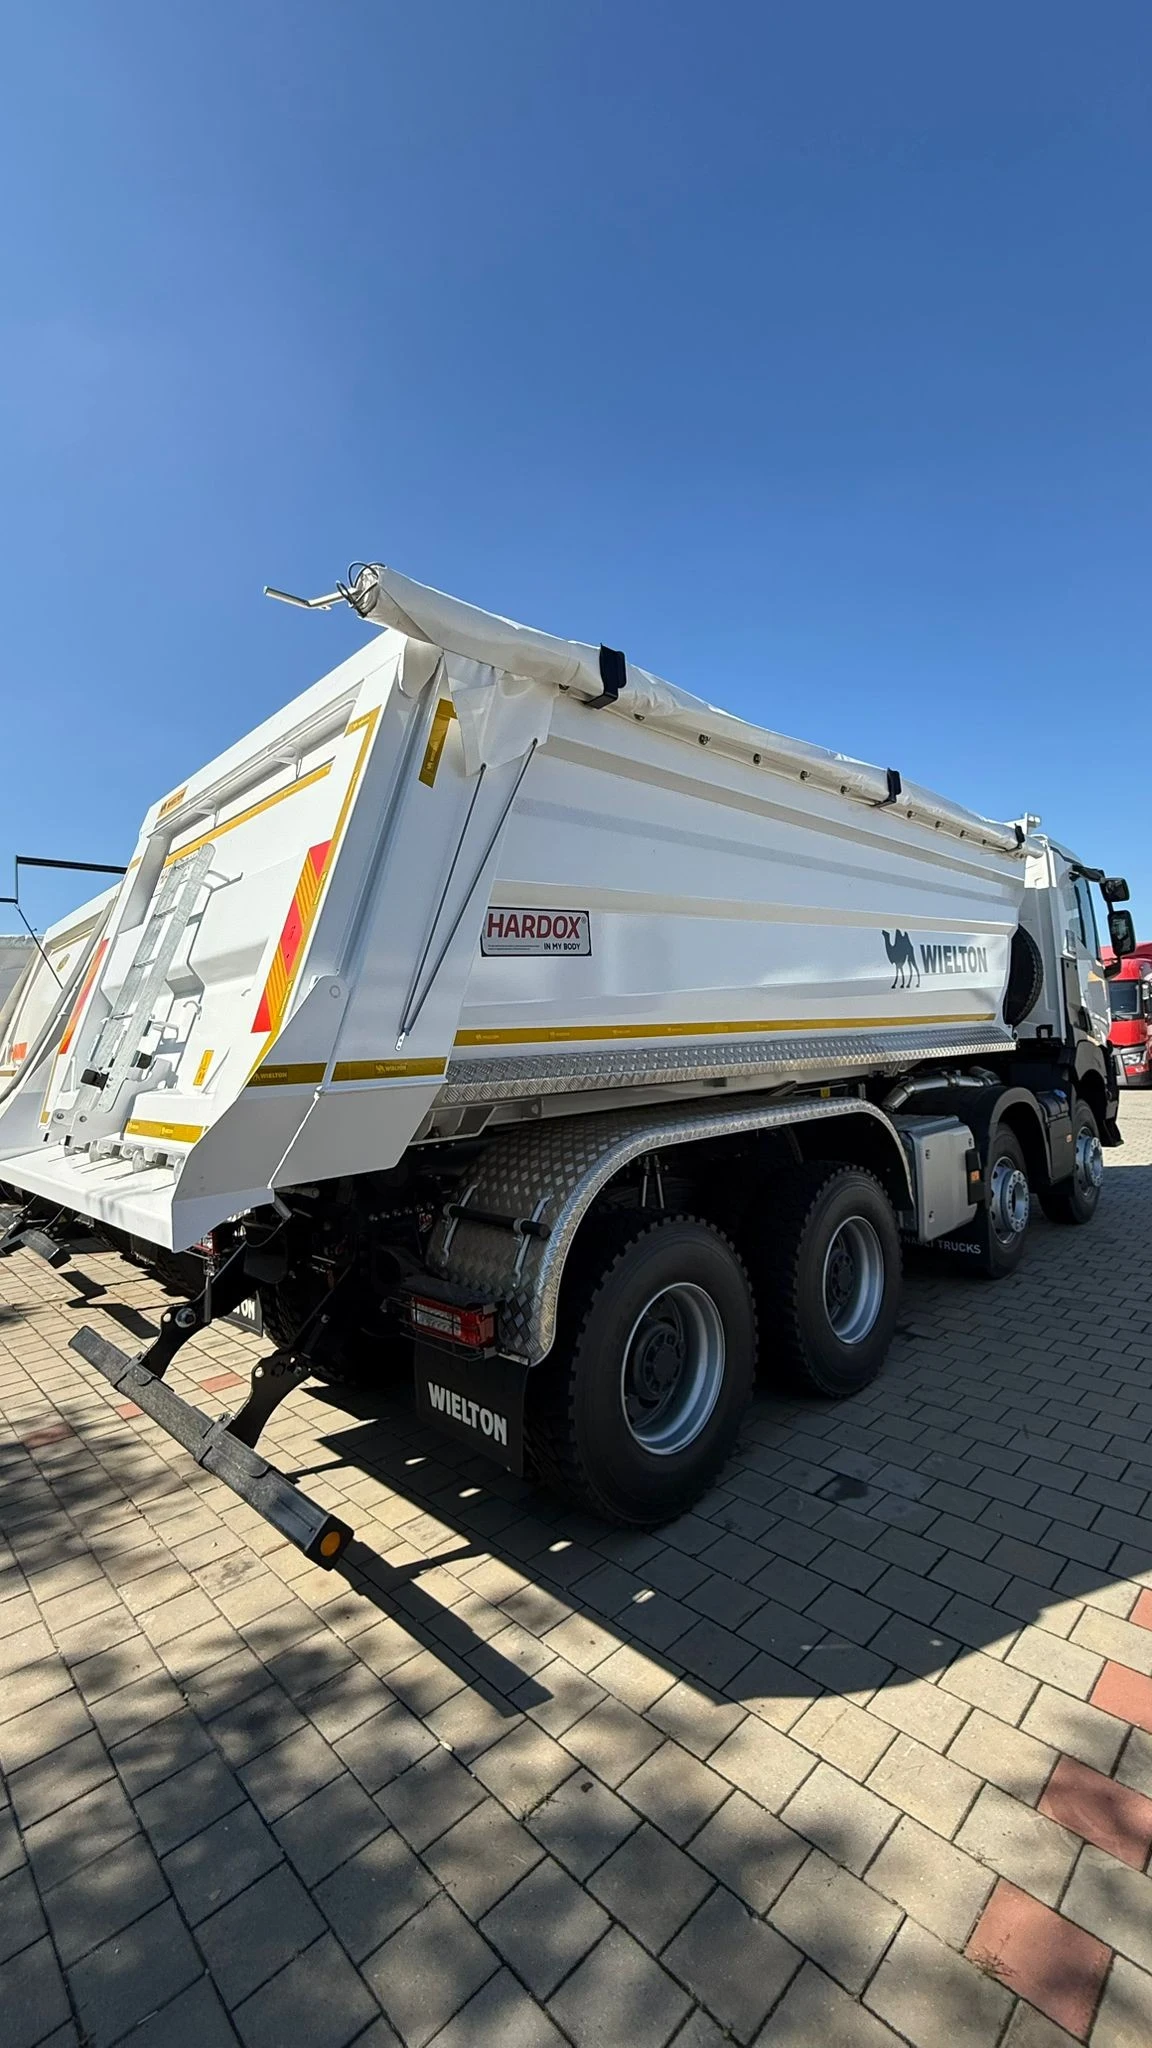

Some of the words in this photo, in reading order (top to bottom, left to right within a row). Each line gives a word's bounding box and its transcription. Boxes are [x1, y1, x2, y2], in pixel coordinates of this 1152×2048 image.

[543, 942, 551, 951] IN
[552, 942, 562, 951] MY
[563, 942, 581, 952] BODY
[920, 944, 988, 974] WIELTON
[938, 1239, 982, 1254] TRUCKS
[427, 1382, 508, 1446] WIELTON
